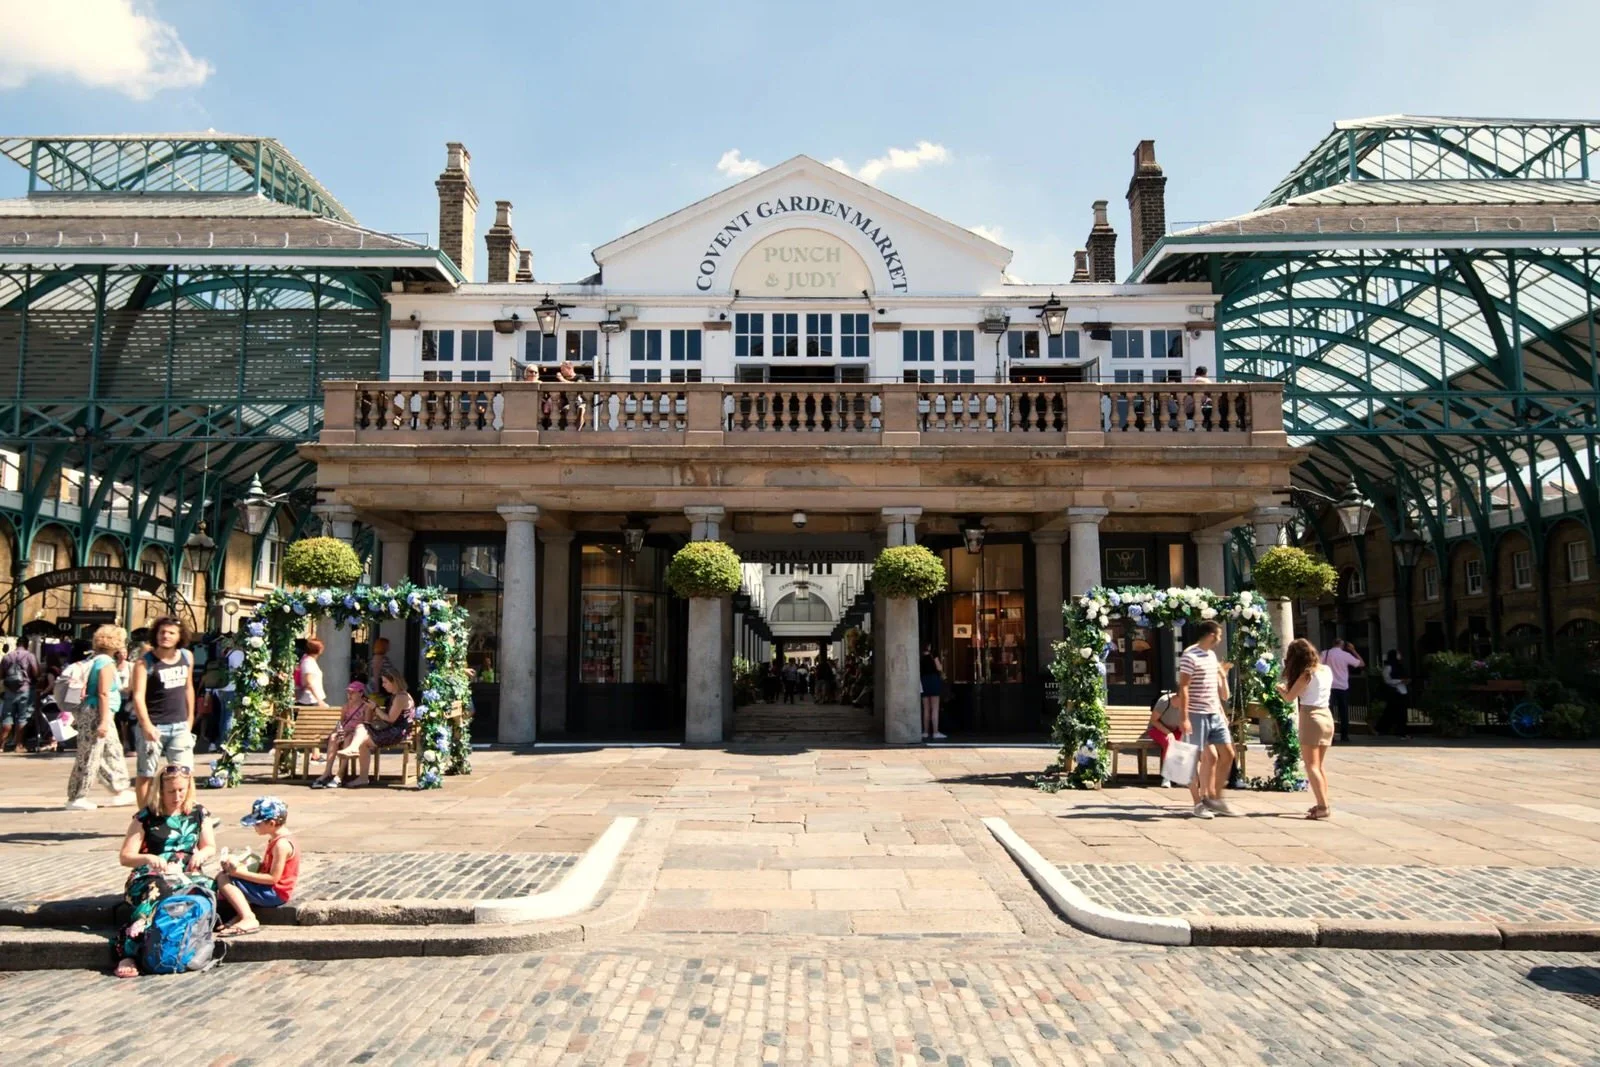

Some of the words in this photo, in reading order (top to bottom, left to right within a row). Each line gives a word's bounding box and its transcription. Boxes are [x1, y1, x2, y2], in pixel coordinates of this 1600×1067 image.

[696, 210, 752, 291] COVENT
[756, 196, 852, 221] GARDEN
[851, 211, 908, 293] MARKET
[764, 247, 841, 263] PUNCH
[765, 273, 779, 288] &
[785, 272, 841, 291] JUDY
[741, 550, 806, 561] CENTRAL
[807, 550, 866, 561] AVENUE
[44, 571, 81, 586] APPLE
[89, 570, 145, 585] MARKET
